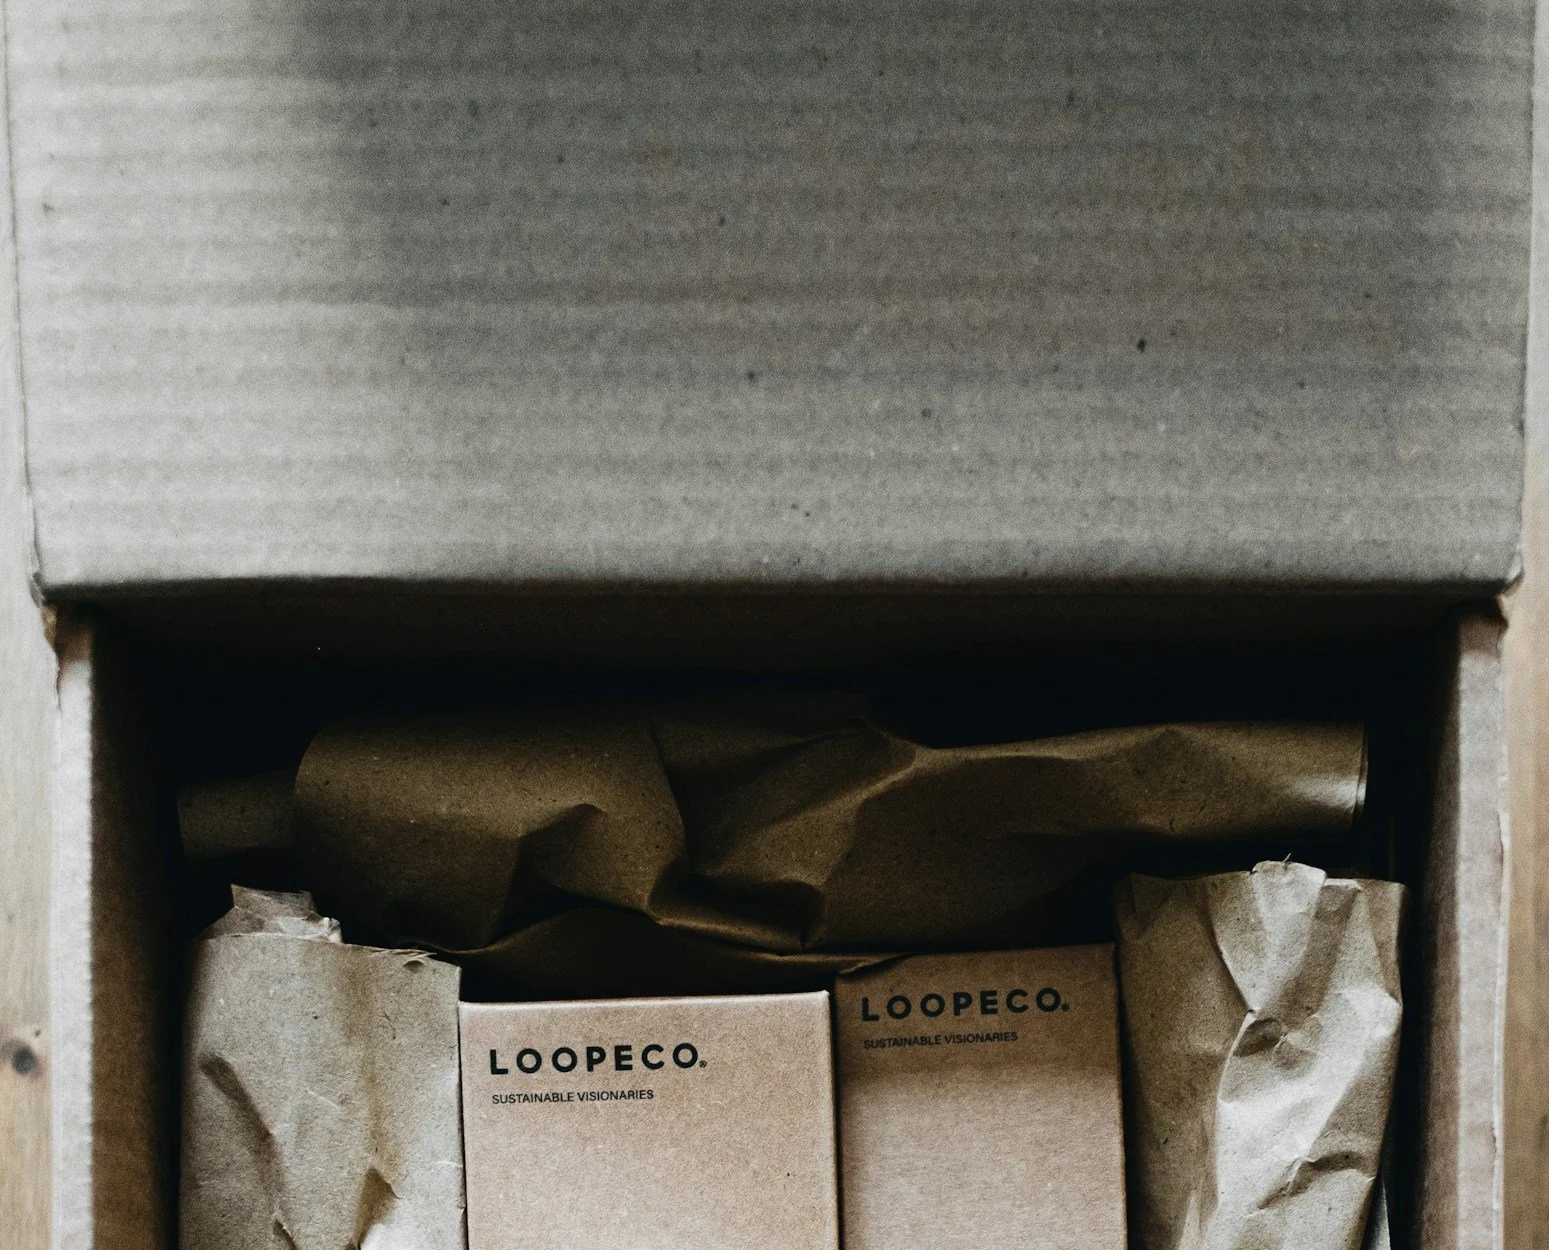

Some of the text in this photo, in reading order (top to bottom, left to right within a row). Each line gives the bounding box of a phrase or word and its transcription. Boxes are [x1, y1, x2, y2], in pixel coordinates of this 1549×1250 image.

[863, 1032, 1018, 1049] SUSTAINABLE VISIONARIES
[492, 1089, 654, 1105] SUSTAINABLE VISIONARIES
